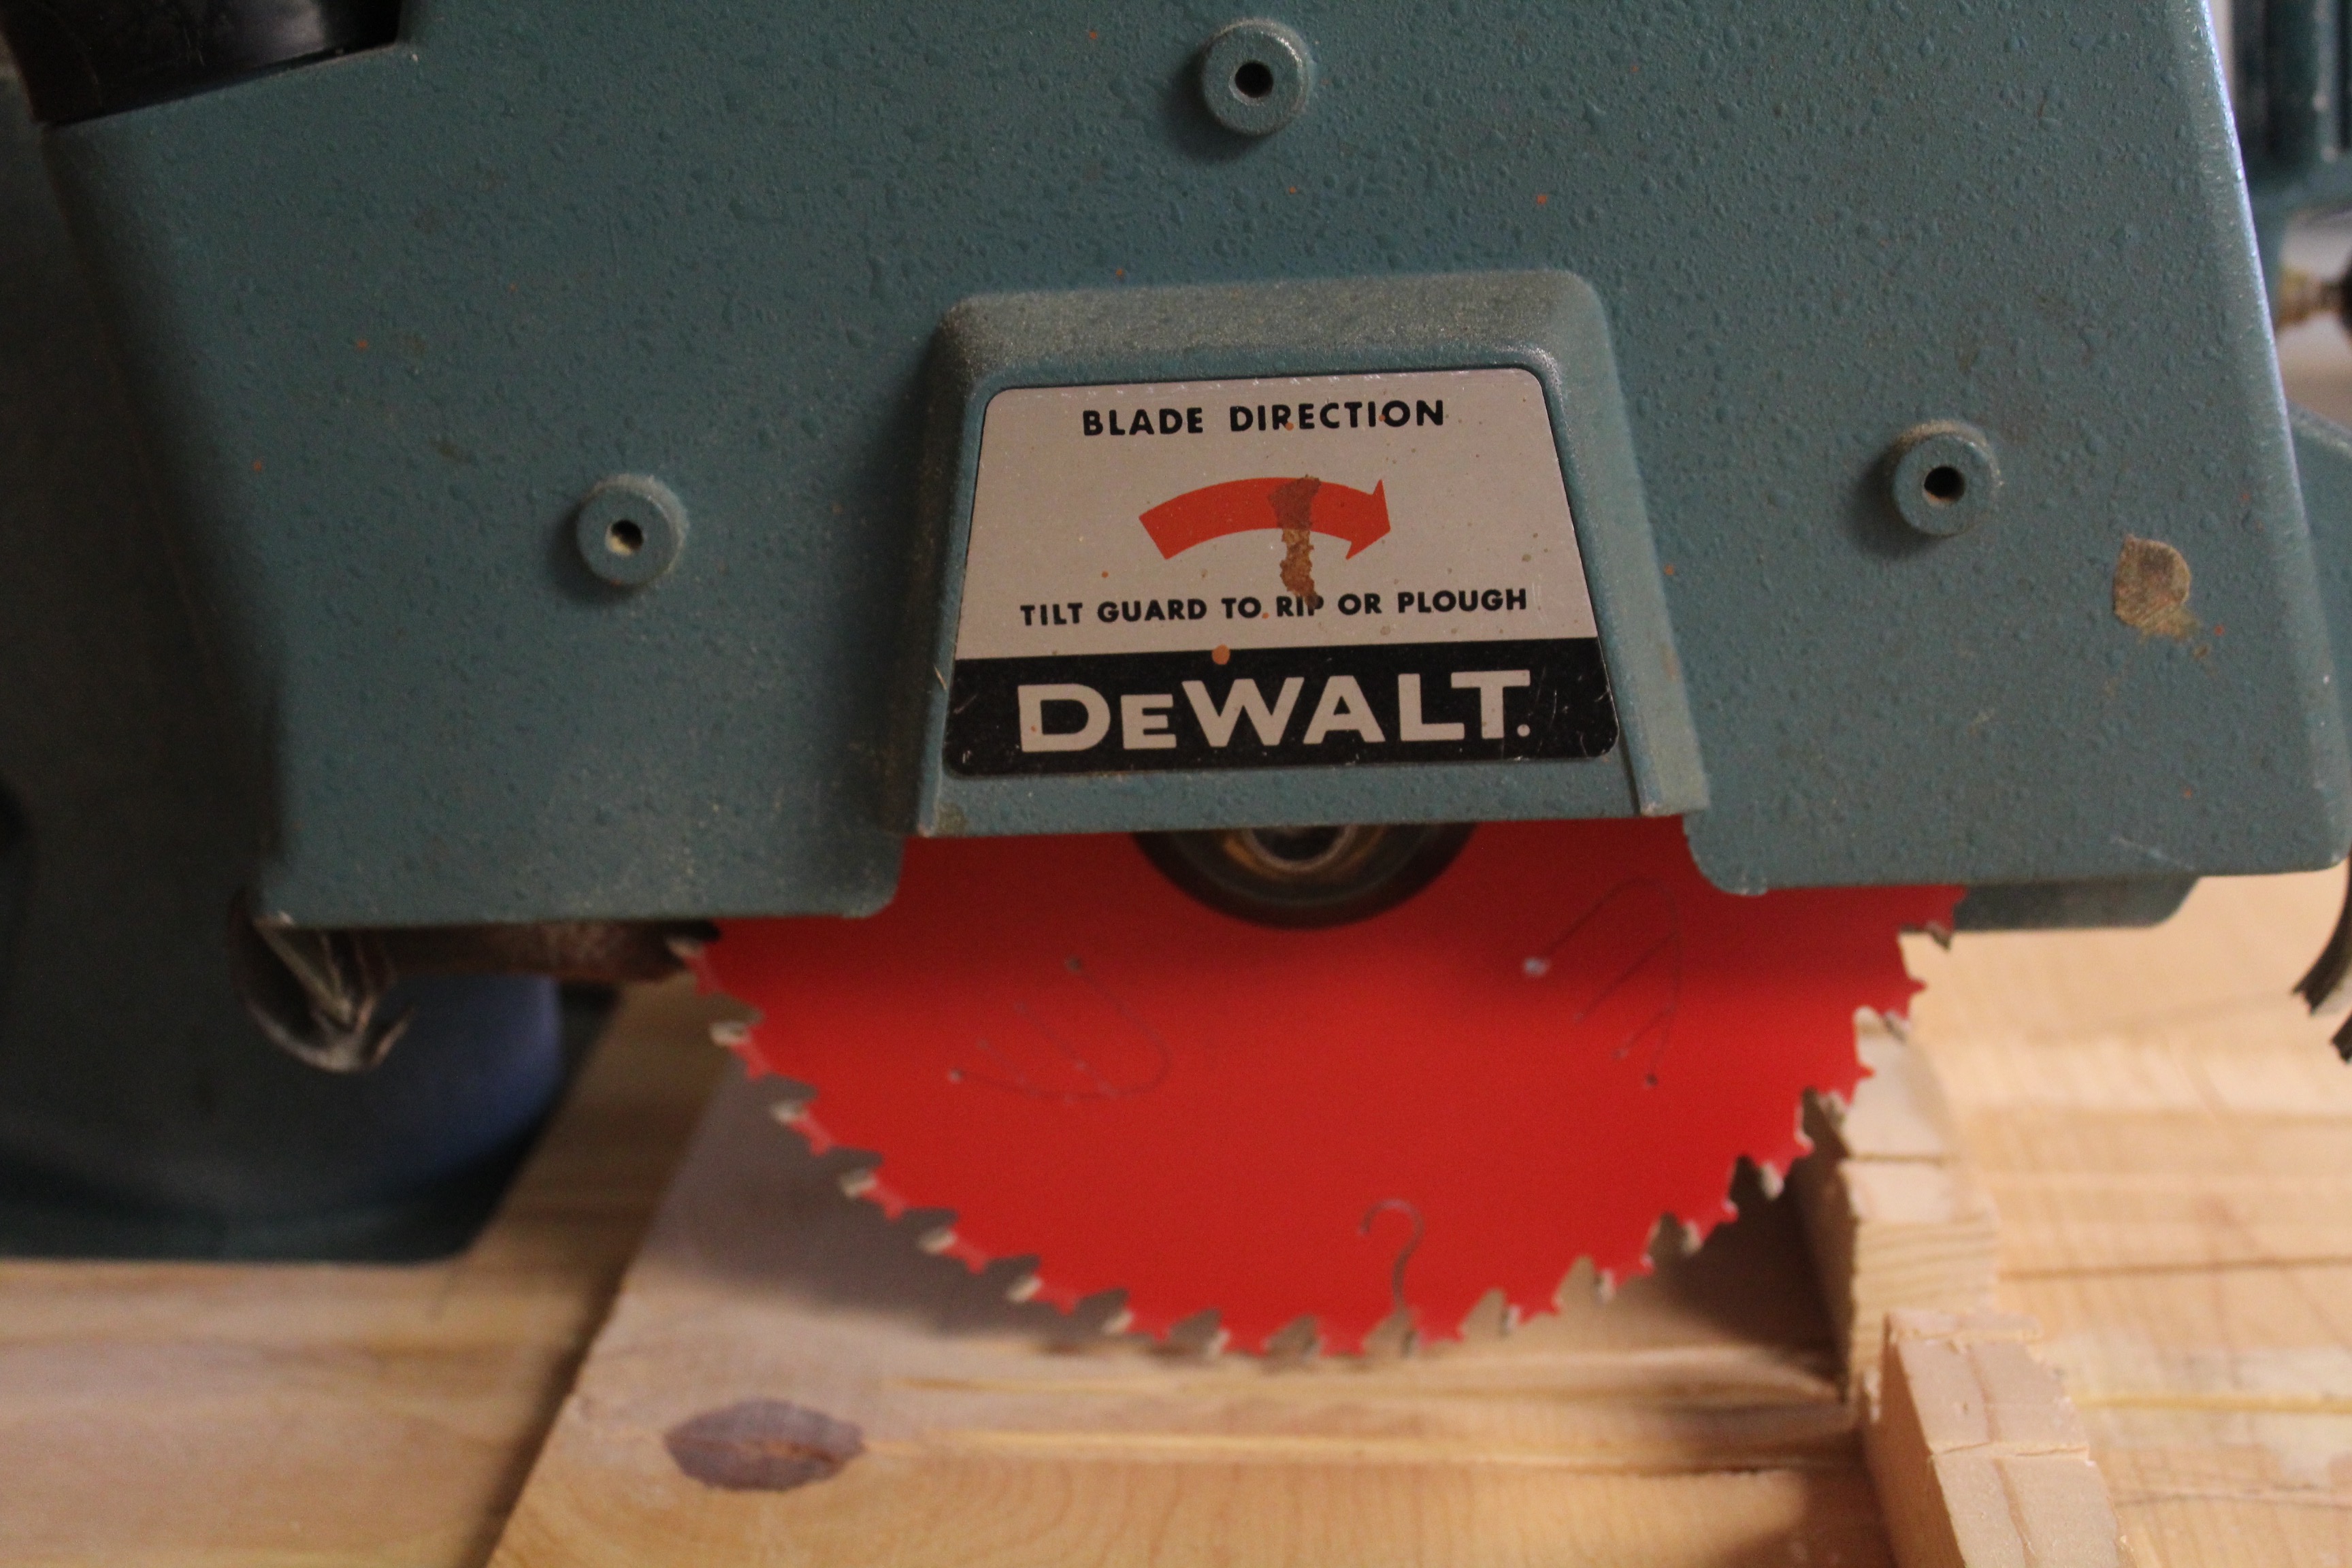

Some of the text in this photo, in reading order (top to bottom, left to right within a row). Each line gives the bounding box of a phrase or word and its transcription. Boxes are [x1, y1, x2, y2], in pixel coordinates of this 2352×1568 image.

[1082, 399, 1444, 436] BLADE DIRECTION
[1019, 588, 1526, 626] TILT GUARD TO RIP OR PLOUGH
